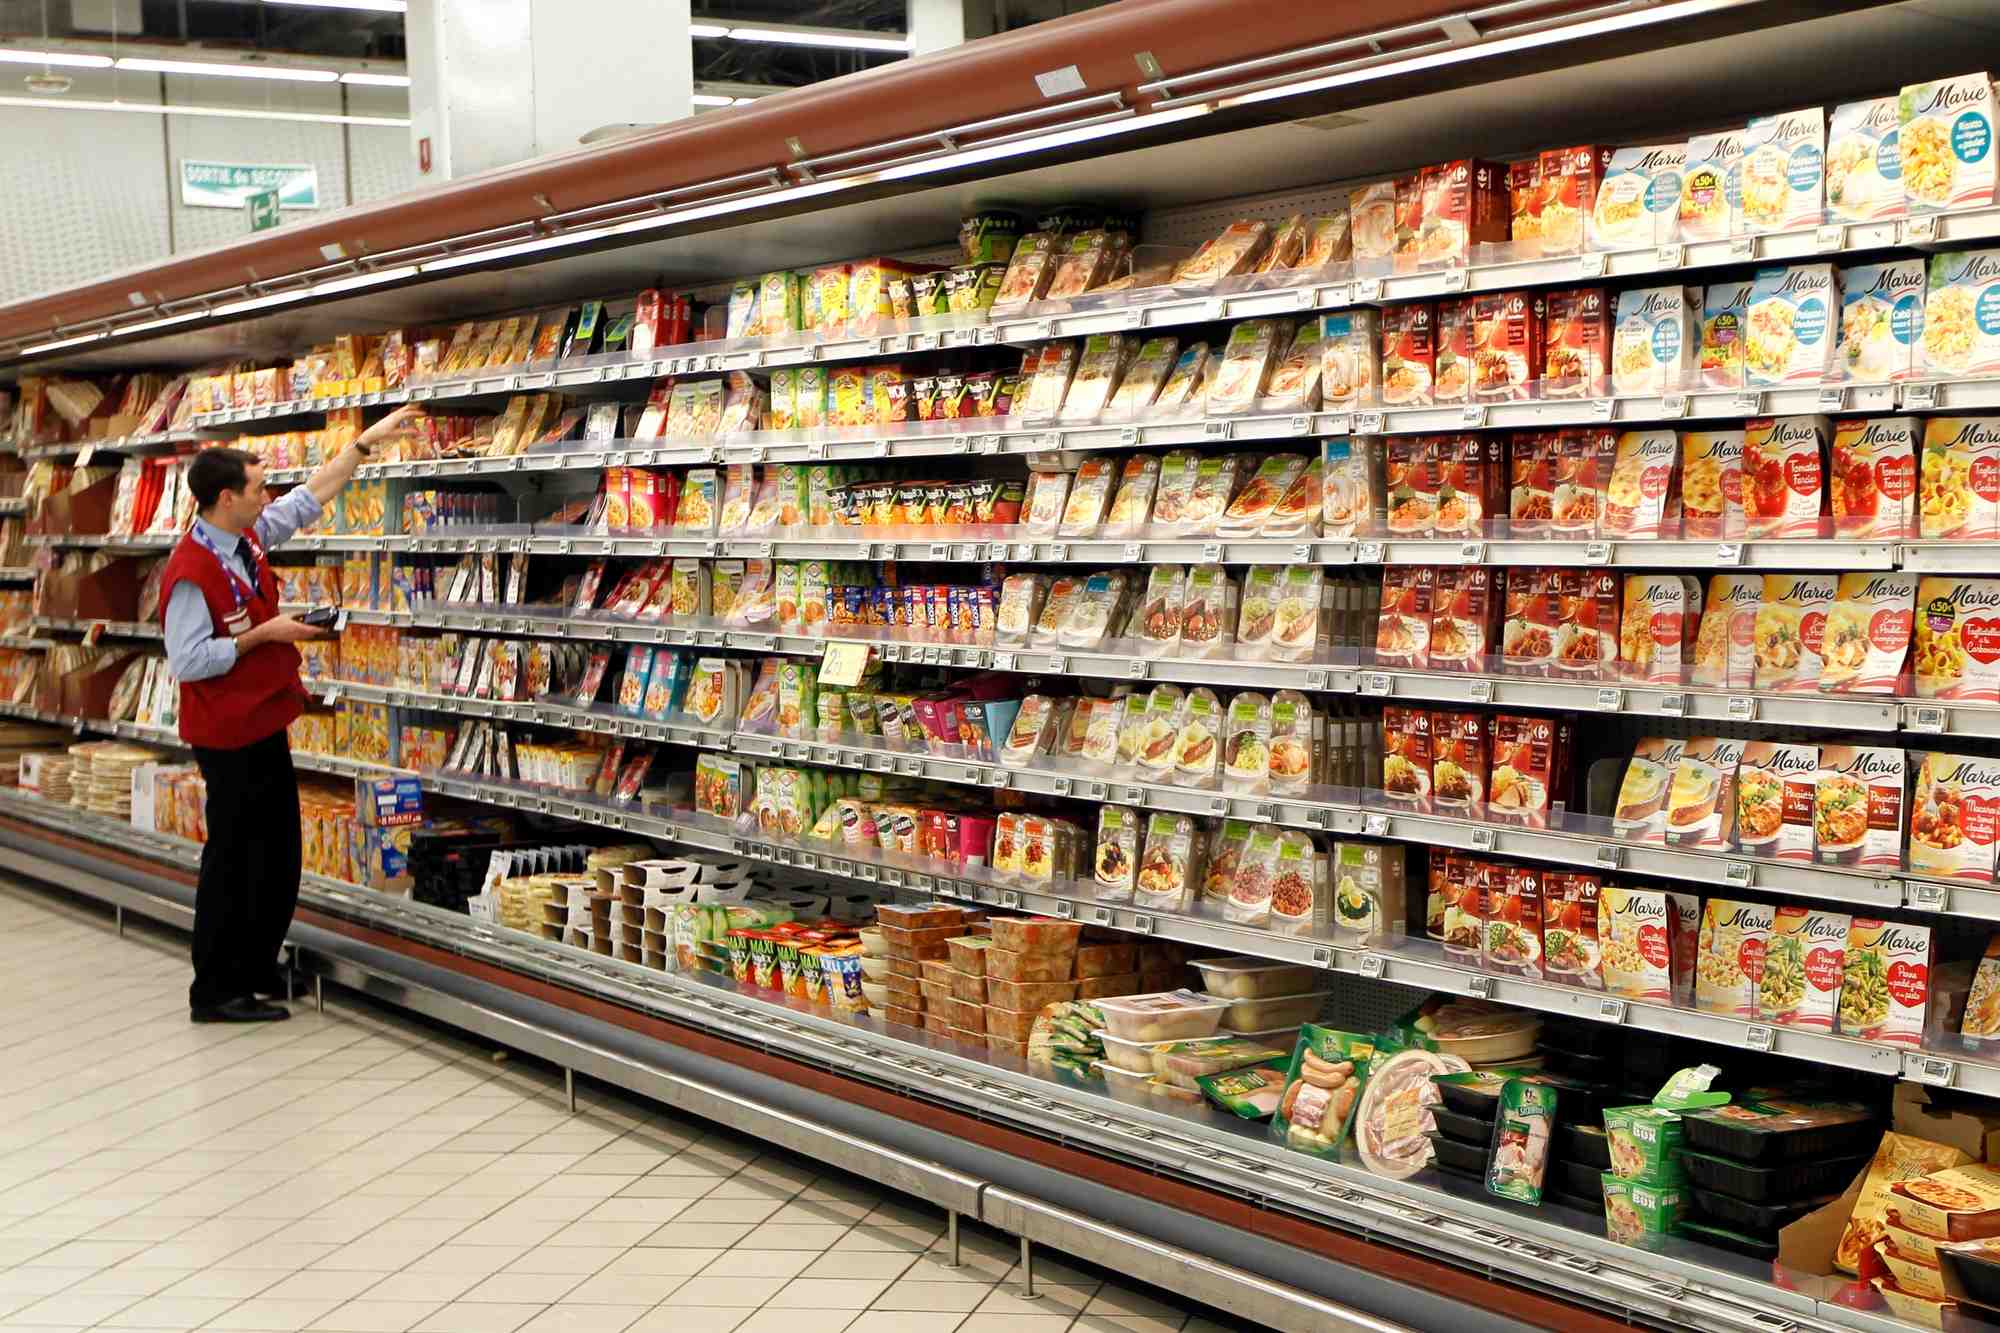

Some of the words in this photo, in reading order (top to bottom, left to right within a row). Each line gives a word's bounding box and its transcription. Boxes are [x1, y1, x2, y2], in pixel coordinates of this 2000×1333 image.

[1919, 84, 1987, 113] Marie
[1762, 119, 1820, 144] Marie
[1626, 150, 1687, 171] Marie
[1774, 272, 1829, 294] Marie
[1864, 268, 1923, 294] Marie
[1632, 294, 1680, 315] Marie
[1761, 423, 1813, 445] Marie
[1851, 425, 1908, 448] Marie
[1945, 424, 2000, 447] Mari
[1631, 439, 1672, 457] Marie
[1638, 585, 1681, 602] Marie
[1779, 578, 1833, 600] Marie
[1853, 578, 1912, 599] Marie
[1758, 750, 1816, 771] Marie
[1838, 752, 1902, 774] Marie
[1615, 896, 1664, 917] Marie
[1720, 908, 1771, 930] Marie
[1788, 916, 1847, 938] Marie
[728, 936, 746, 949] MAXI
[750, 939, 773, 953] MAXI
[1864, 928, 1927, 952] Marie
[777, 946, 798, 960] MAXI
[799, 954, 820, 968] MAXI
